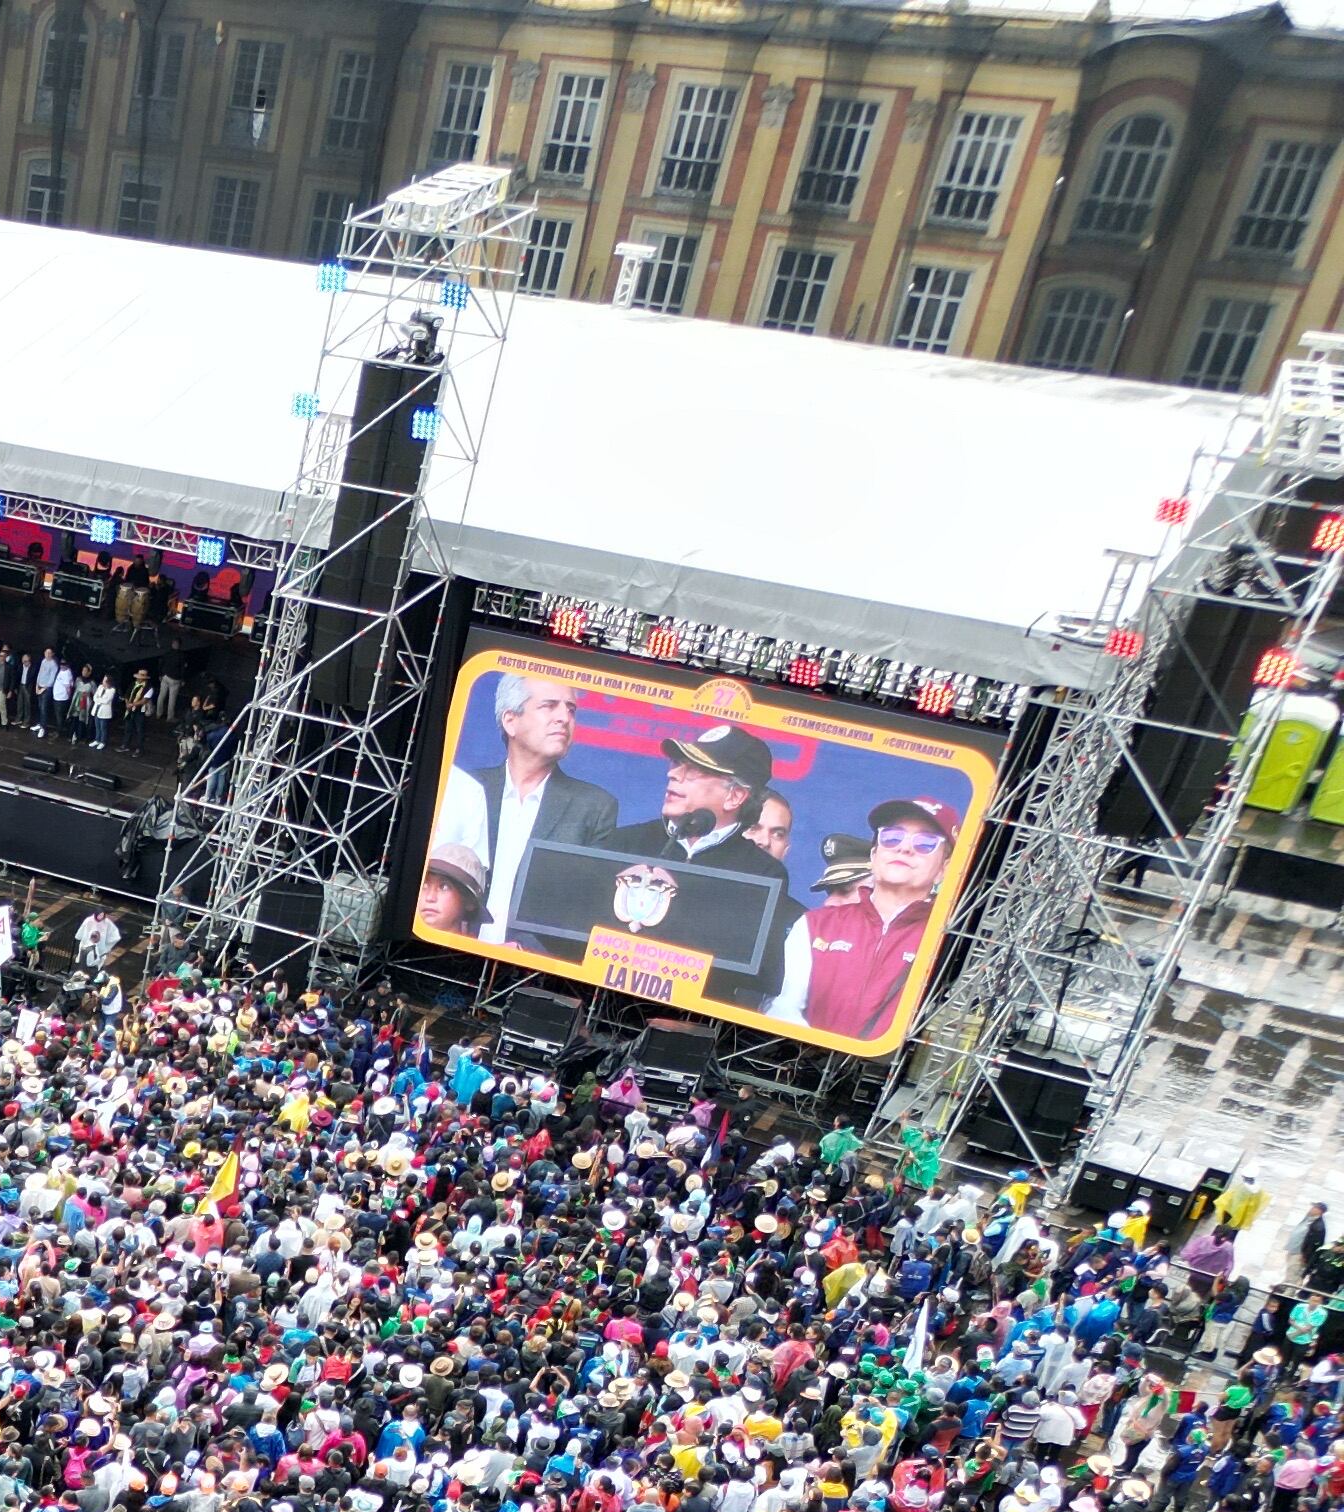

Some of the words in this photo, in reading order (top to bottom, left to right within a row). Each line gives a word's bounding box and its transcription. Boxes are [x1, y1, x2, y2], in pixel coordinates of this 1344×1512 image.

[497, 655, 527, 669] PACTOS
[528, 661, 574, 681] CULTURALES
[575, 672, 592, 684] POR
[593, 675, 602, 686] LA
[604, 677, 623, 690] VIDA
[630, 683, 646, 695] POR
[647, 686, 658, 697] LA
[659, 688, 674, 700] PAZ
[714, 687, 737, 707] 27
[695, 703, 745, 720] SEPTIEMBRE
[595, 934, 630, 951] #NOS
[635, 943, 705, 970] MOVEMOS
[631, 957, 660, 972] POR
[605, 964, 628, 990] LA
[630, 970, 673, 1001] VIDA
